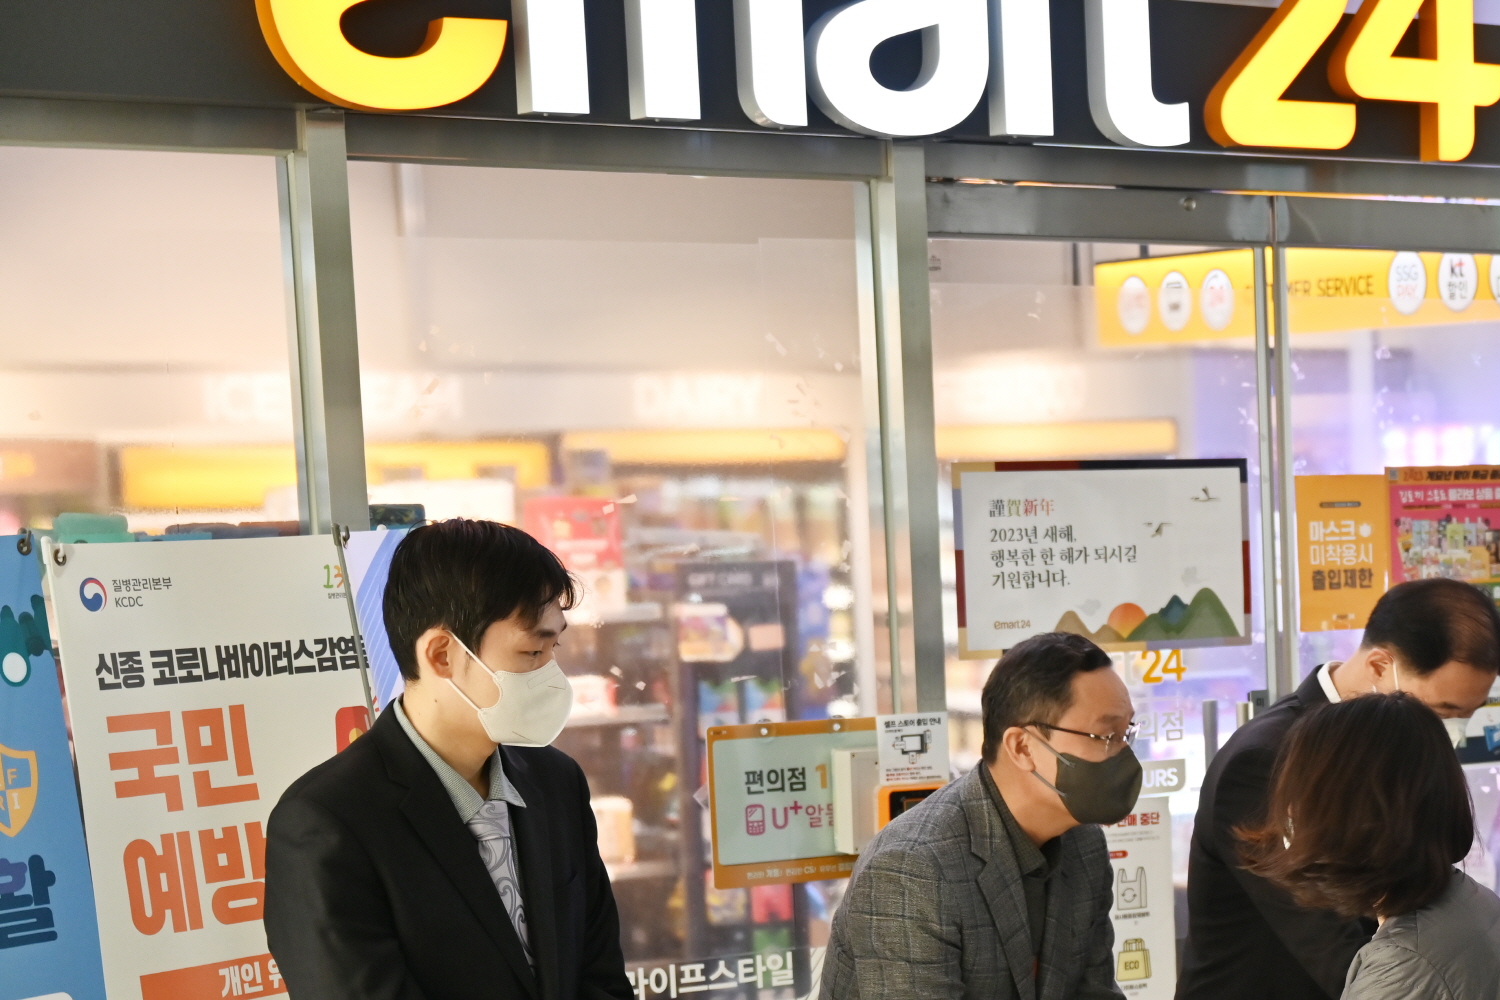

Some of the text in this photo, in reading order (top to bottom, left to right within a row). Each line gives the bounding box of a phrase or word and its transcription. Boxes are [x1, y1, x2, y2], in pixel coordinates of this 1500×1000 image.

[1317, 274, 1374, 298] SERVICE
[990, 525, 1077, 545] 2023년 새해,
[1309, 520, 1357, 541] 마스크
[991, 545, 1138, 568] 행복한 한 해가 되시길
[1310, 543, 1373, 566] 미착용시
[111, 576, 173, 593] 질병관리본부
[992, 570, 1071, 590] 기원합니다.
[1312, 568, 1373, 591] 출입제한
[114, 595, 144, 608] KCDC
[95, 651, 145, 691] 신종
[106, 703, 260, 812] 국민
[745, 766, 807, 795] 편의점
[1124, 960, 1140, 971] ECO
[219, 963, 263, 998] 개인
